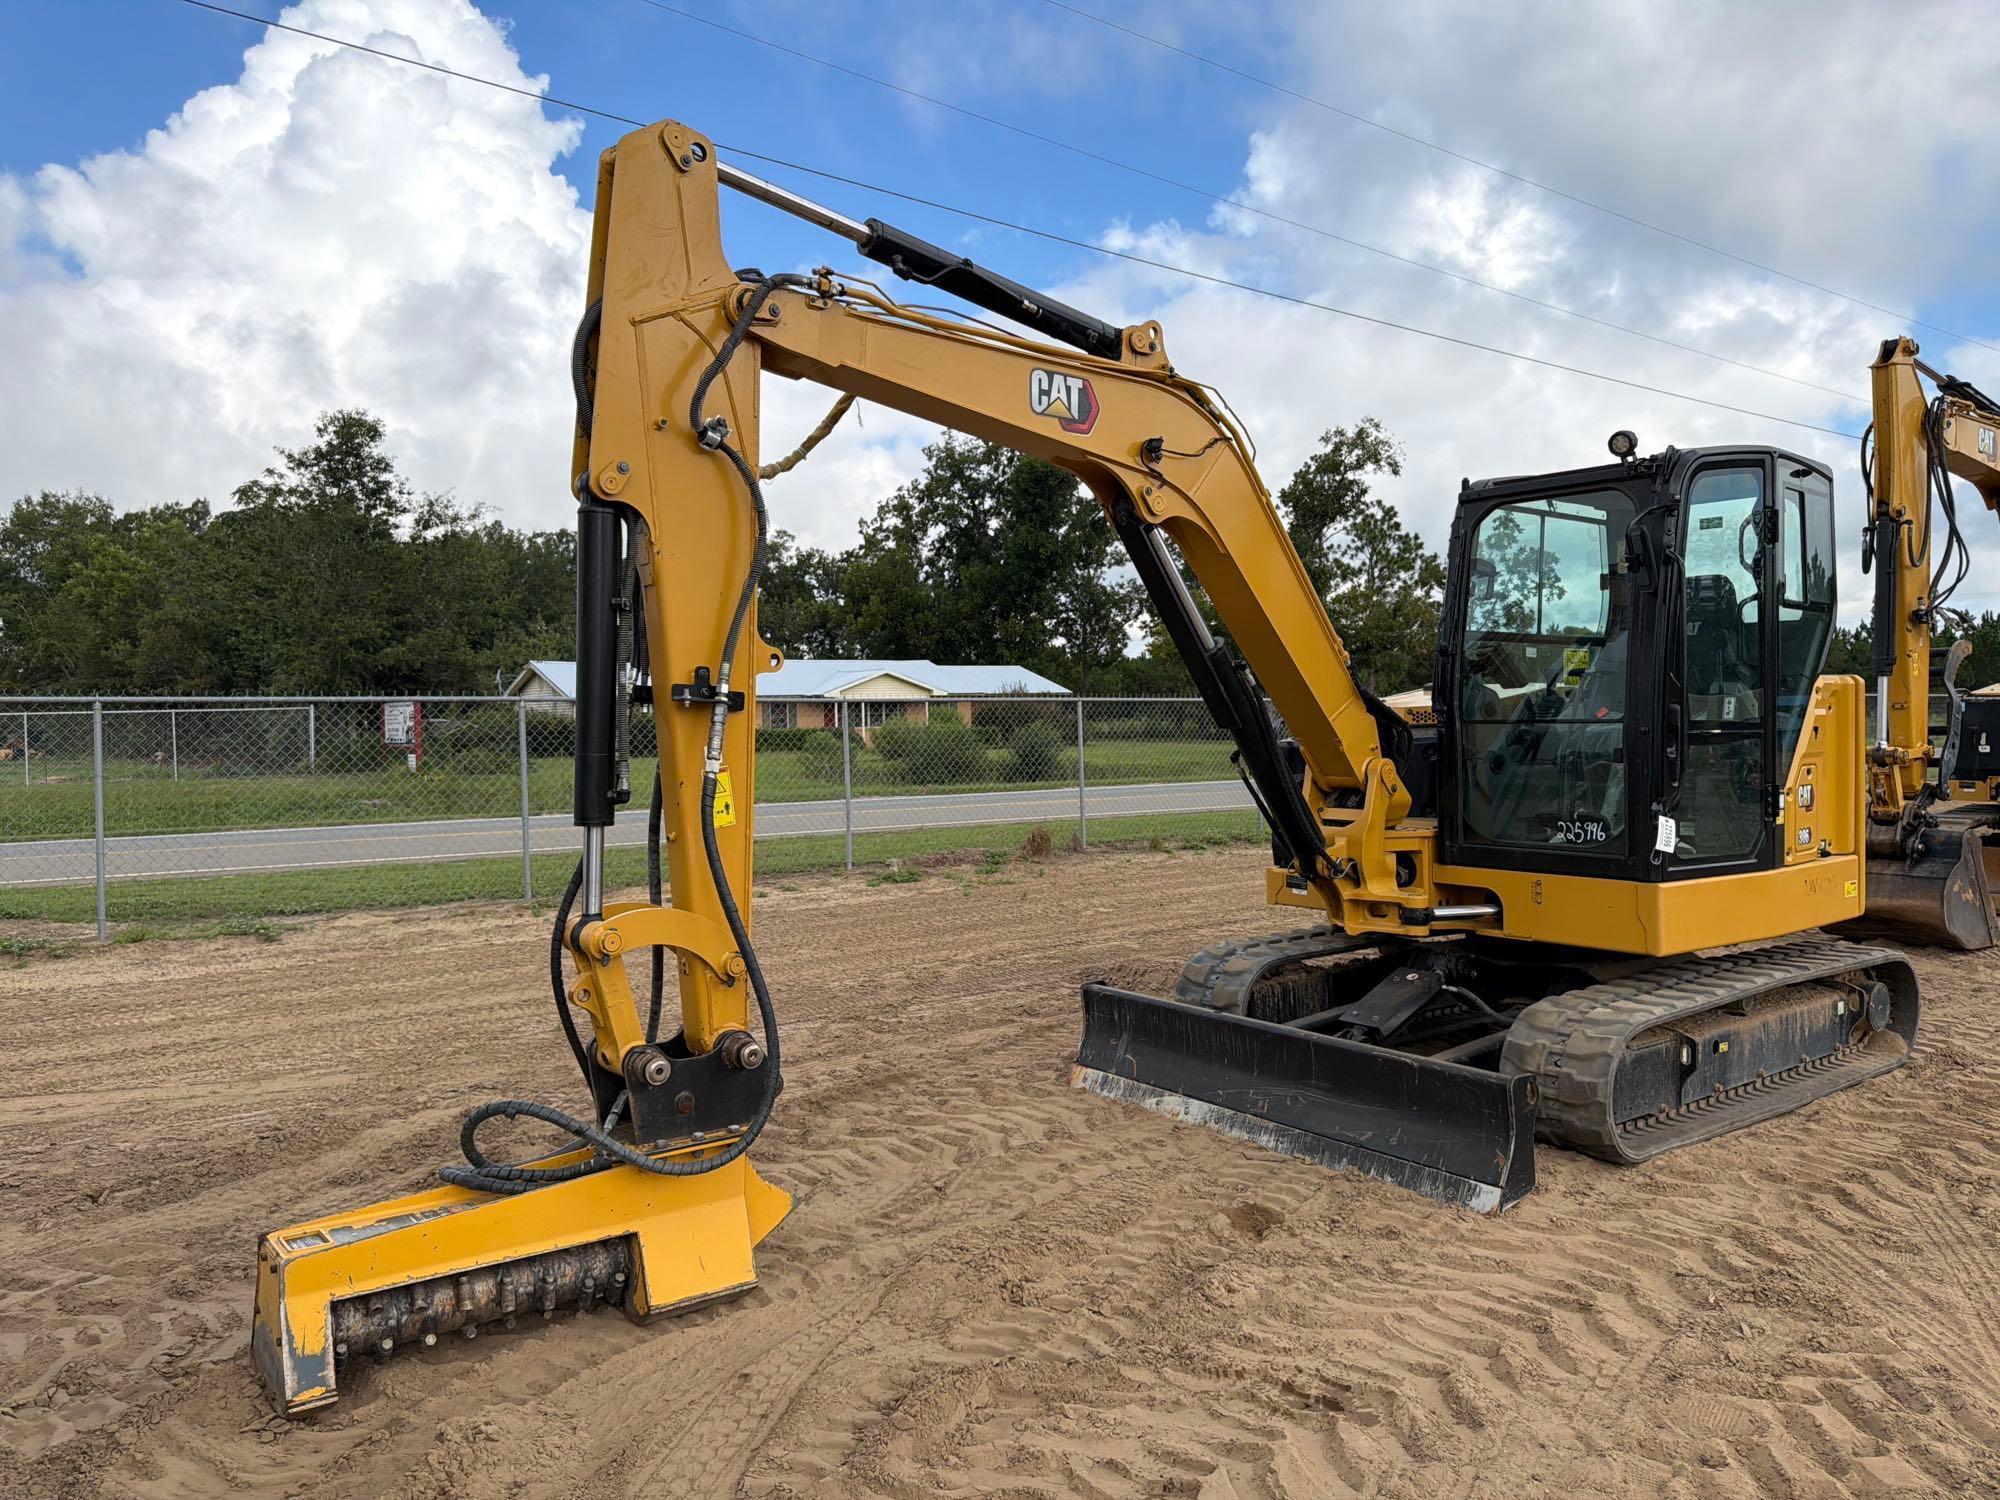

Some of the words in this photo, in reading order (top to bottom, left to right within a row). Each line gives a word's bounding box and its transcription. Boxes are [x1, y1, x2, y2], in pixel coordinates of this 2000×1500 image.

[1031, 368, 1083, 421] CAT
[1979, 427, 1995, 456] CAT
[1798, 784, 1812, 807] CAT
[1557, 821, 1606, 843] 225996
[1663, 823, 1673, 848] 225996
[1798, 828, 1810, 844] 306
